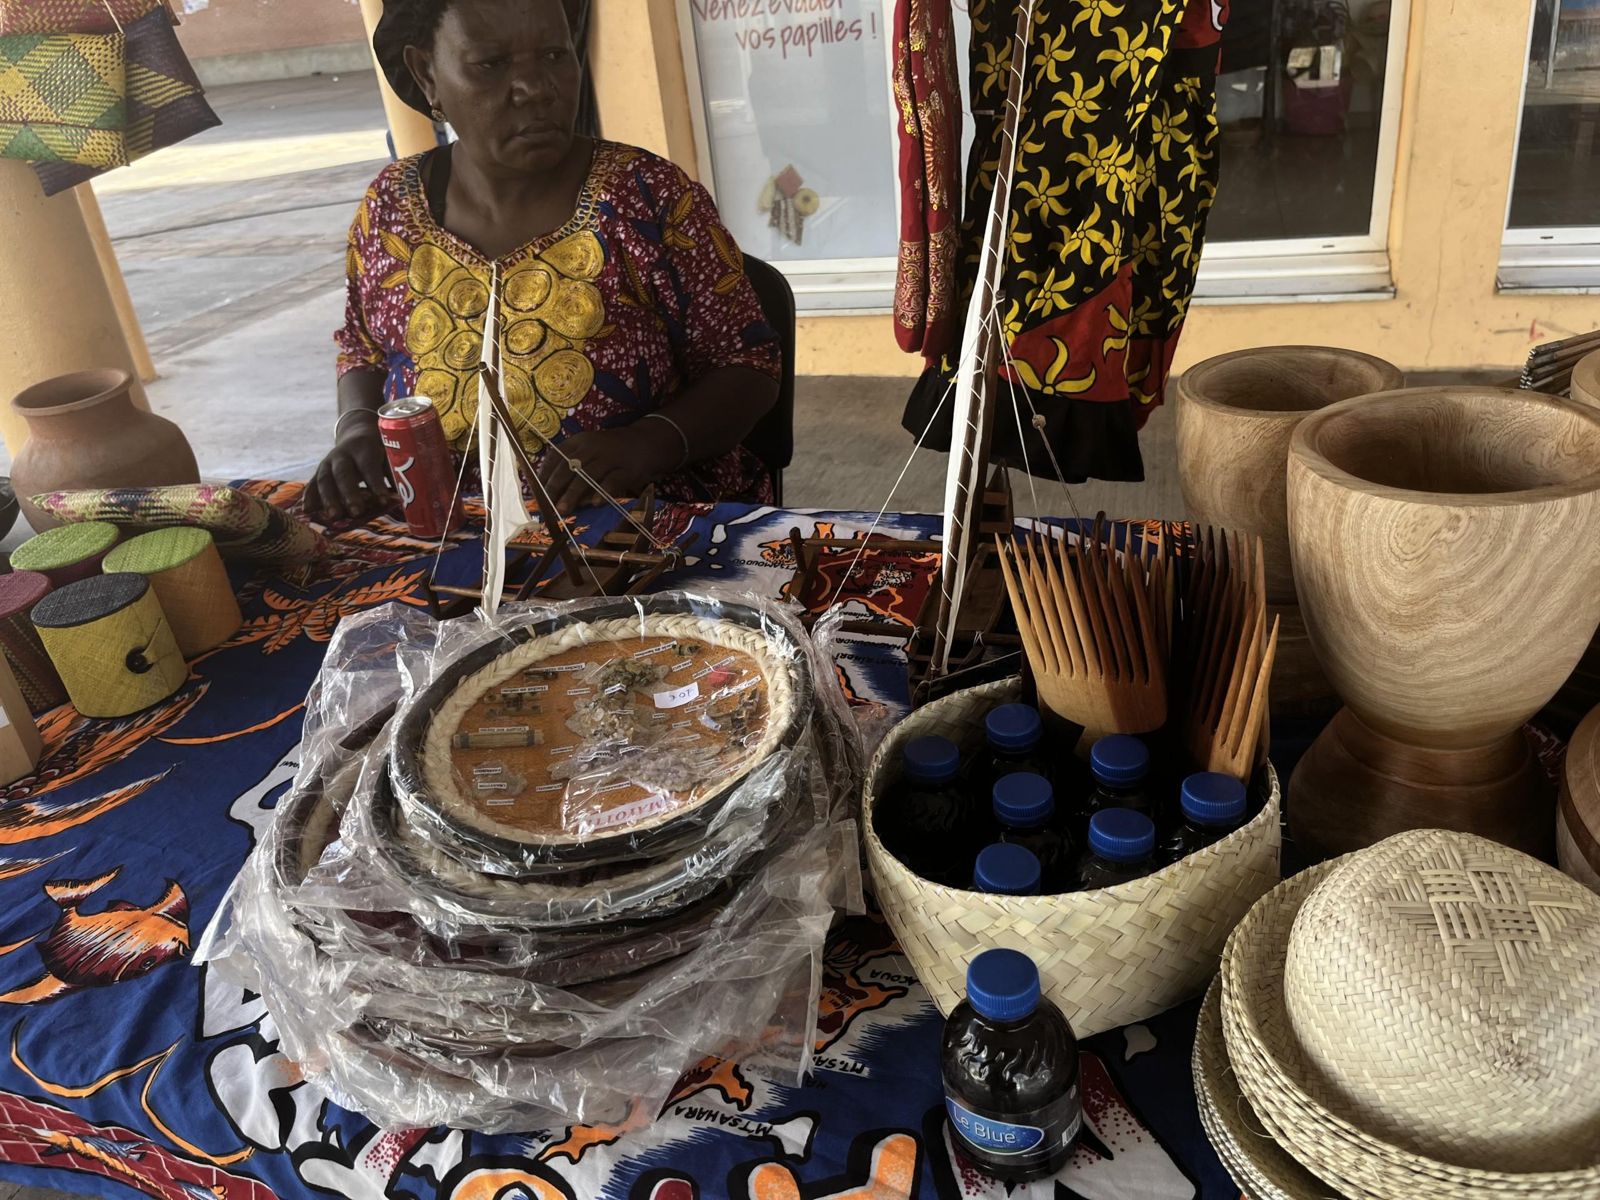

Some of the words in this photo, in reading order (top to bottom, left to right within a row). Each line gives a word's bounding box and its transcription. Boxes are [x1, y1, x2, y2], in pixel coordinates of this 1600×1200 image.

[735, 26, 776, 51] vos
[780, 16, 863, 59] papilles
[870, 12, 878, 39] !
[953, 1105, 970, 1130] Le
[974, 1121, 1017, 1144] Blue
